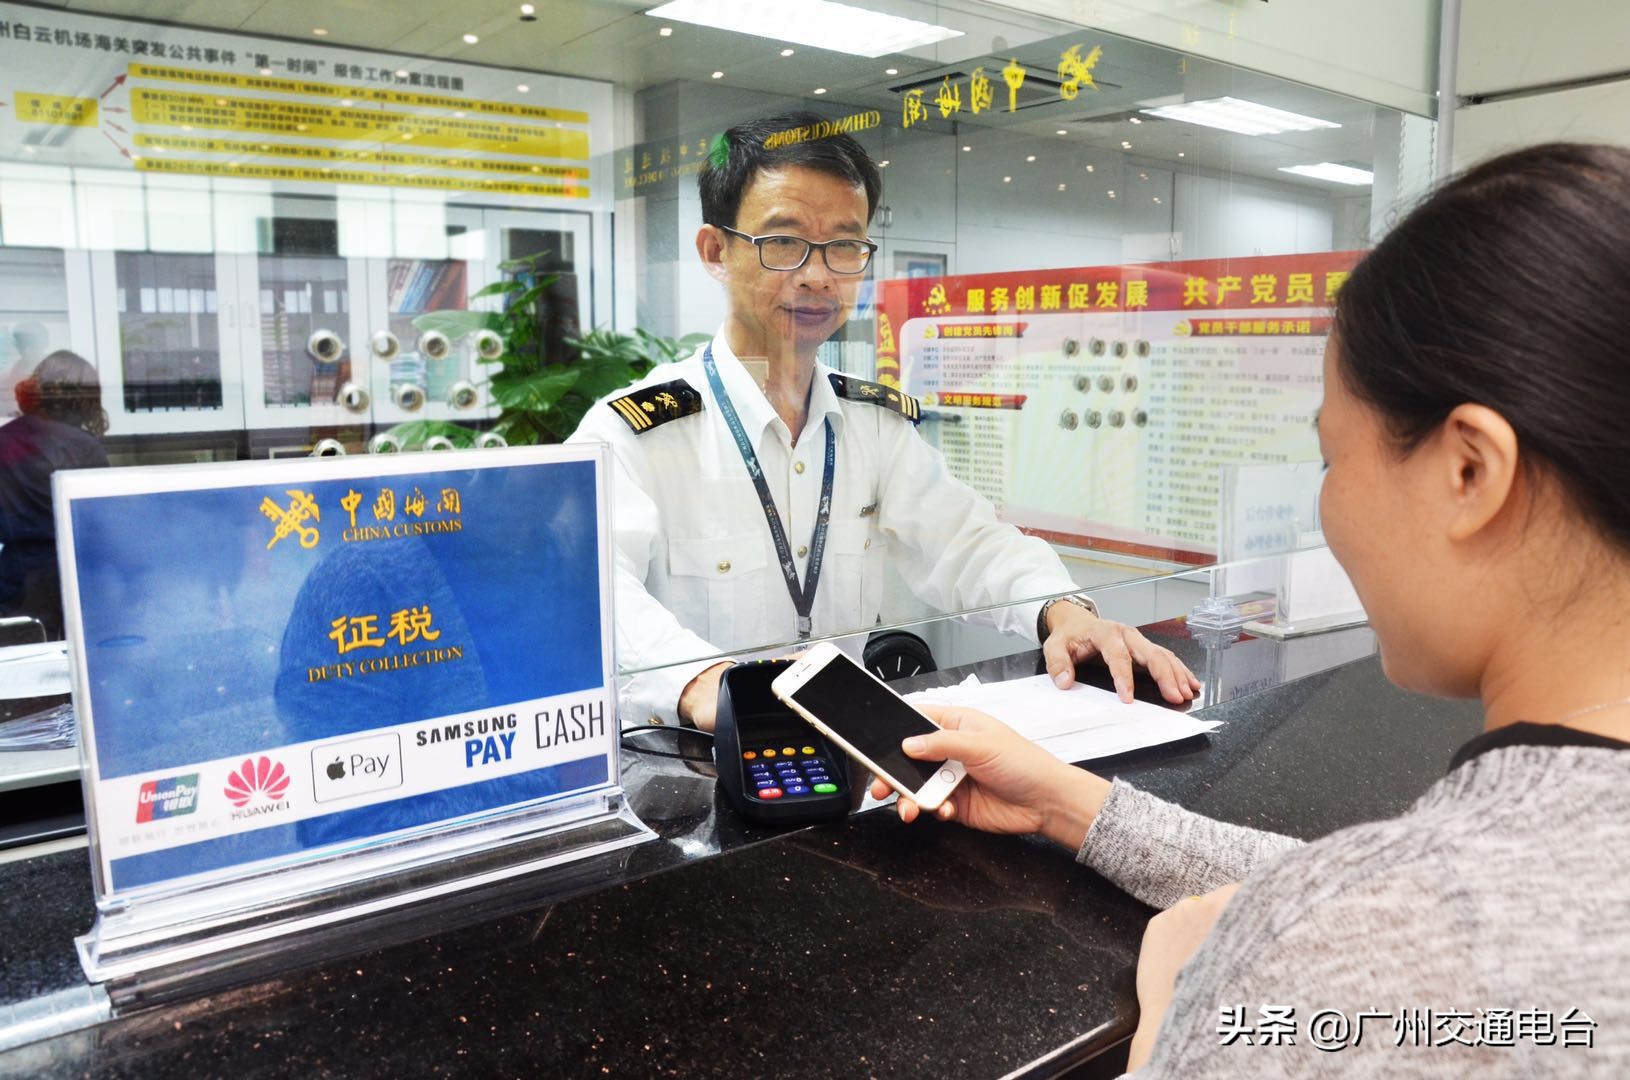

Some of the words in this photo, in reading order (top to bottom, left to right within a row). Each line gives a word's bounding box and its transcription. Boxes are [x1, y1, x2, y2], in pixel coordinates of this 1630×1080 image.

[966, 280, 1148, 313] 服务创新促发展
[343, 525, 391, 542] CHINA
[393, 519, 463, 538] CUSTOMS
[329, 605, 440, 654] 征税
[307, 660, 356, 682] DUTY
[359, 645, 464, 674] COLLECTION
[416, 713, 518, 746] SAMSUNG
[535, 700, 604, 749] CASH
[350, 753, 390, 778] Pay
[465, 731, 517, 768] PAY
[139, 784, 198, 804] UnionPay
[230, 800, 290, 820] HUAWEI
